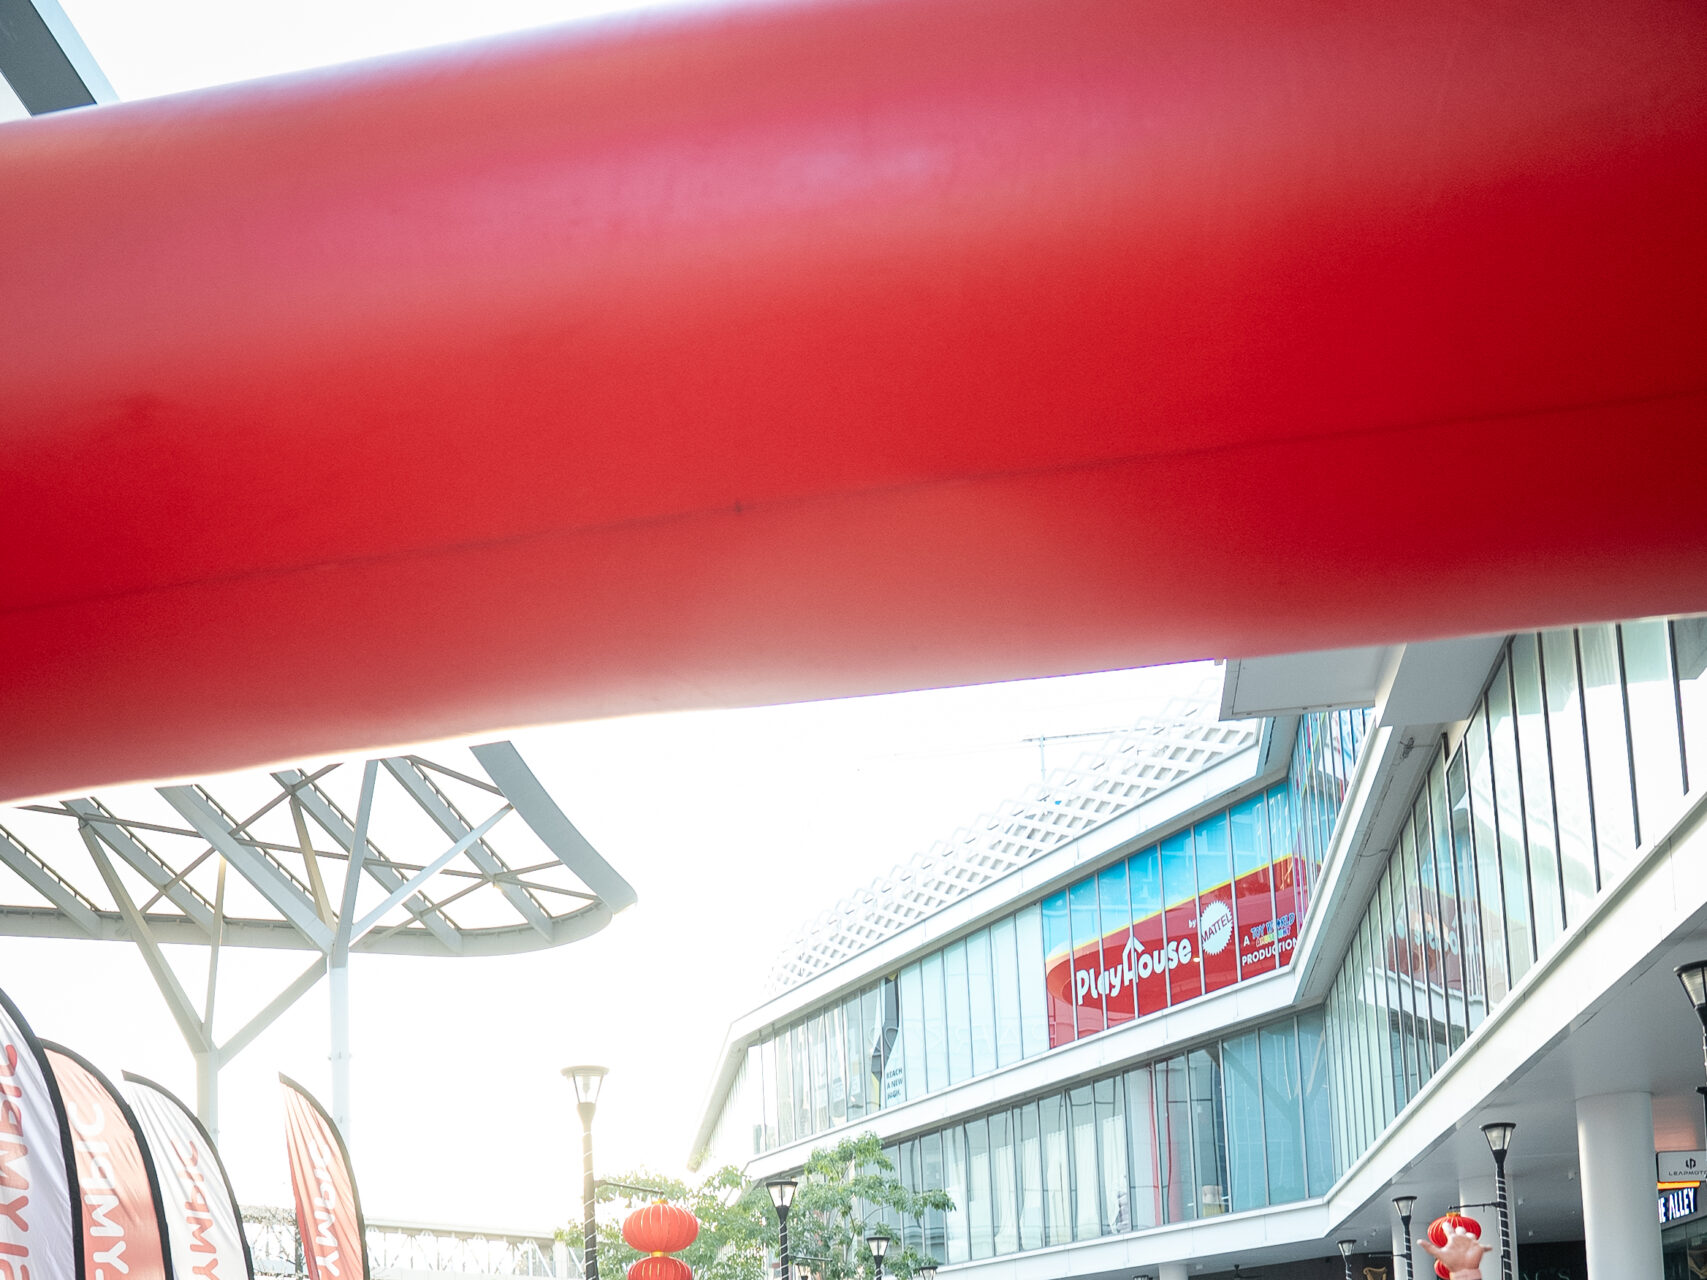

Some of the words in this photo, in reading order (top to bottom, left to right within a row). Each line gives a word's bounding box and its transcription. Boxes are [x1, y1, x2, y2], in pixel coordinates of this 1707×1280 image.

[1201, 913, 1232, 942] MATTEL
[1243, 935, 1250, 947] A
[1251, 924, 1265, 940] TOY
[1668, 1187, 1696, 1221] ALLEY
